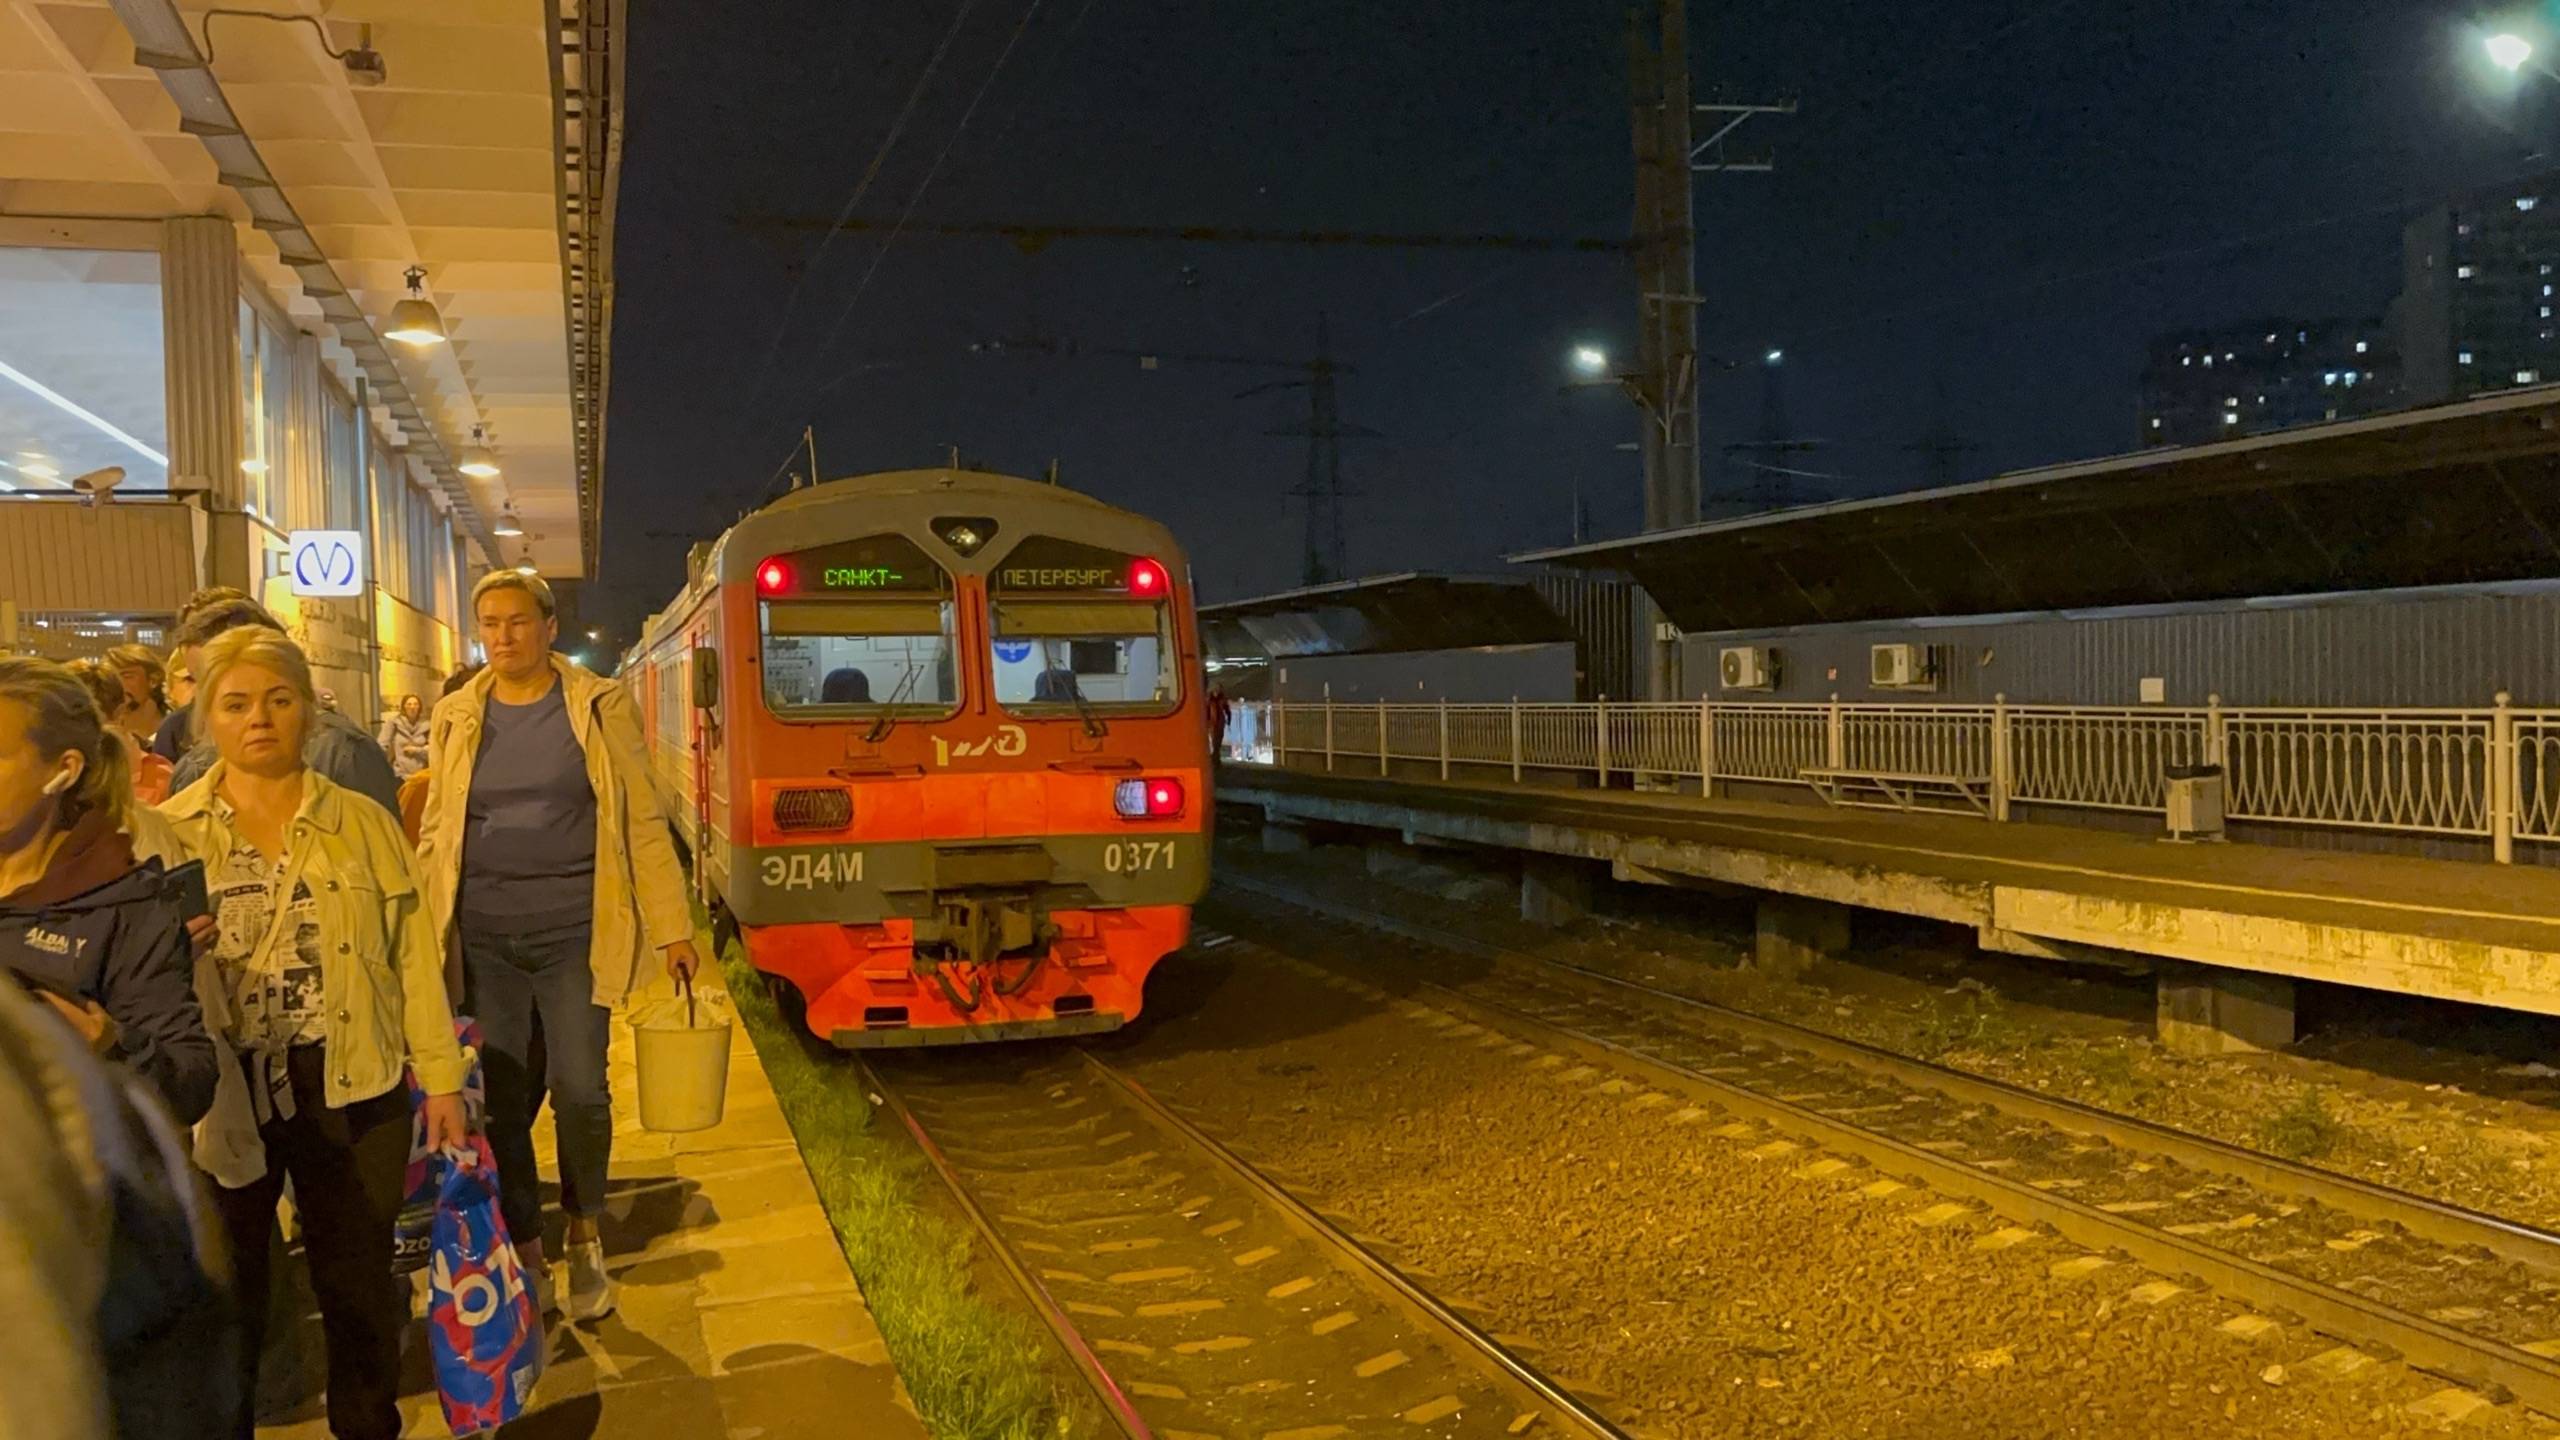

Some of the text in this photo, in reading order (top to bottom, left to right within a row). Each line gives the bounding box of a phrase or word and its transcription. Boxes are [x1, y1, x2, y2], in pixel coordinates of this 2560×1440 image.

[824, 568, 903, 586] САНКТ-
[1104, 840, 1175, 872] 0371
[761, 851, 863, 891] ЭД4М
[25, 927, 88, 952] ALBAY
[395, 1236, 431, 1255] OZO
